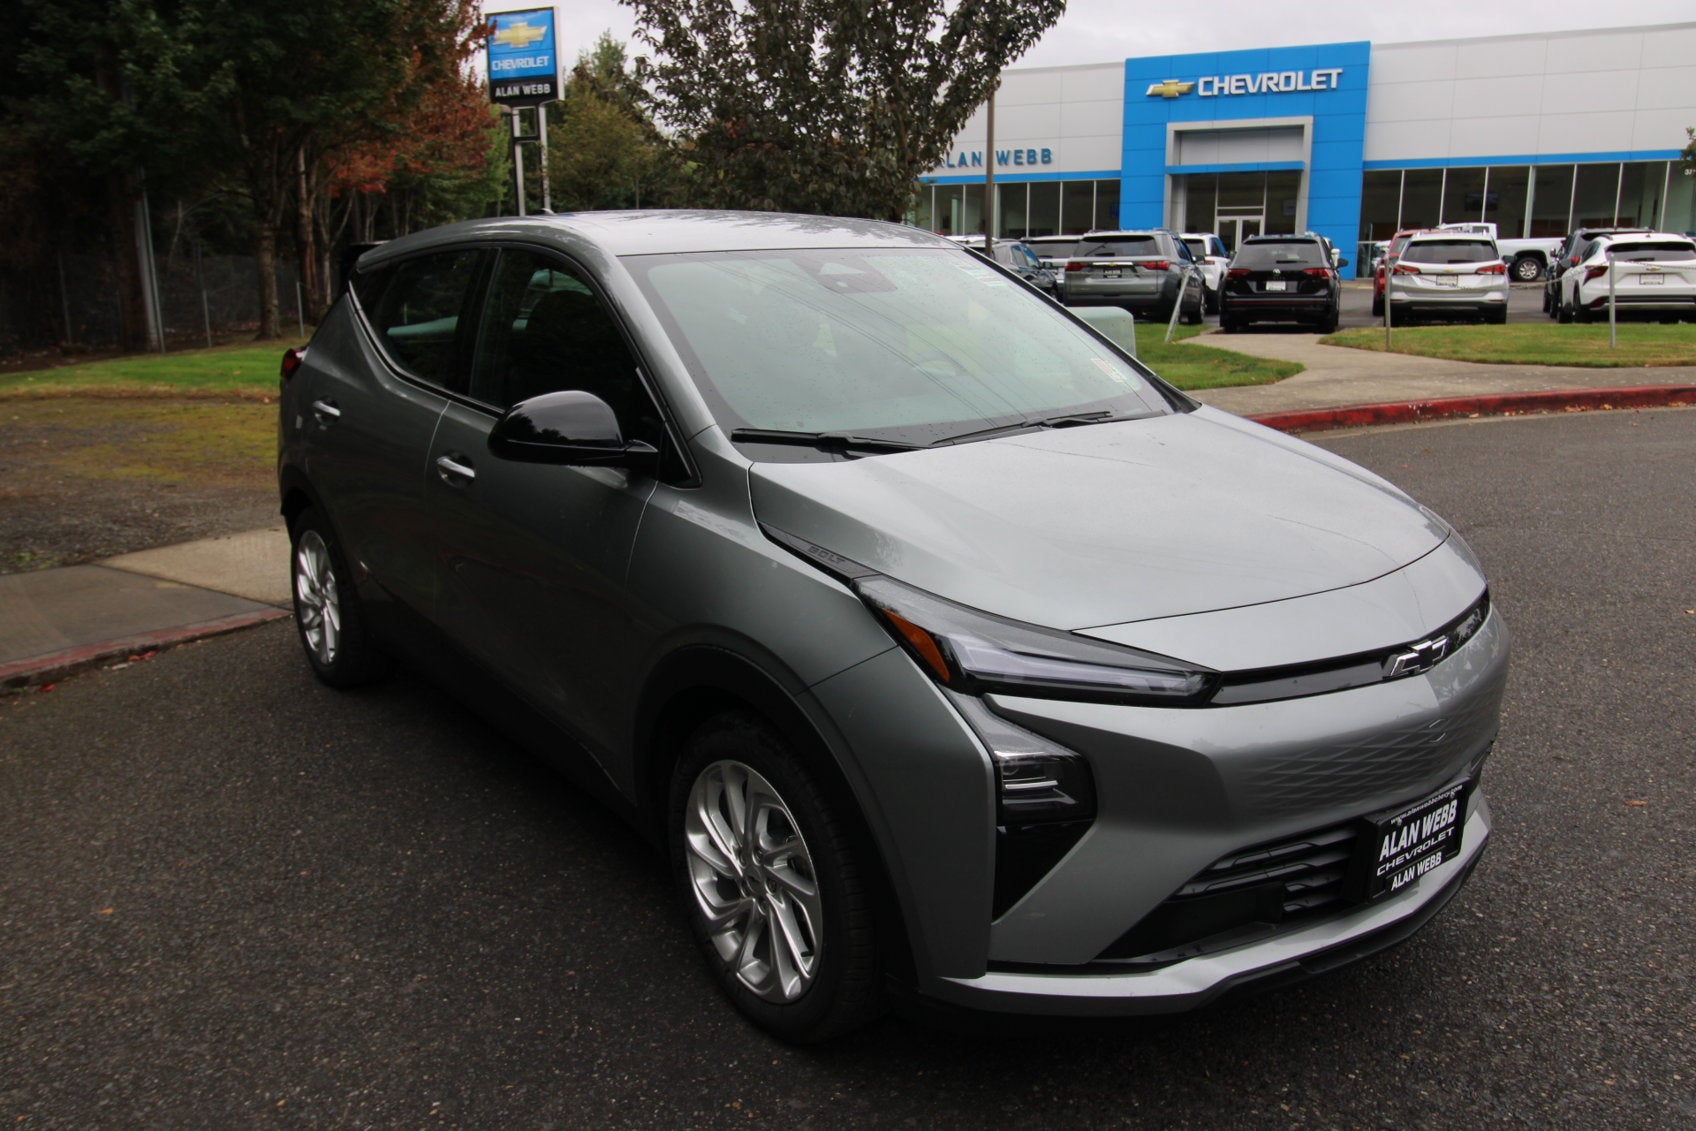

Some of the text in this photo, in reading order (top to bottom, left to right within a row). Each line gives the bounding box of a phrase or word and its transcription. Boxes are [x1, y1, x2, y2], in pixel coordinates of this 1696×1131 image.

[491, 56, 549, 71] CHEVROLET
[495, 83, 551, 97] ALAN WEBB
[1198, 68, 1343, 97] CHEVROLET
[995, 148, 1052, 166] WEBB
[807, 545, 846, 563] BOLT
[1379, 799, 1458, 862] ALAN WEBB
[1377, 826, 1455, 876] CHEVROLET
[1391, 851, 1442, 891] ALAN WEBB
